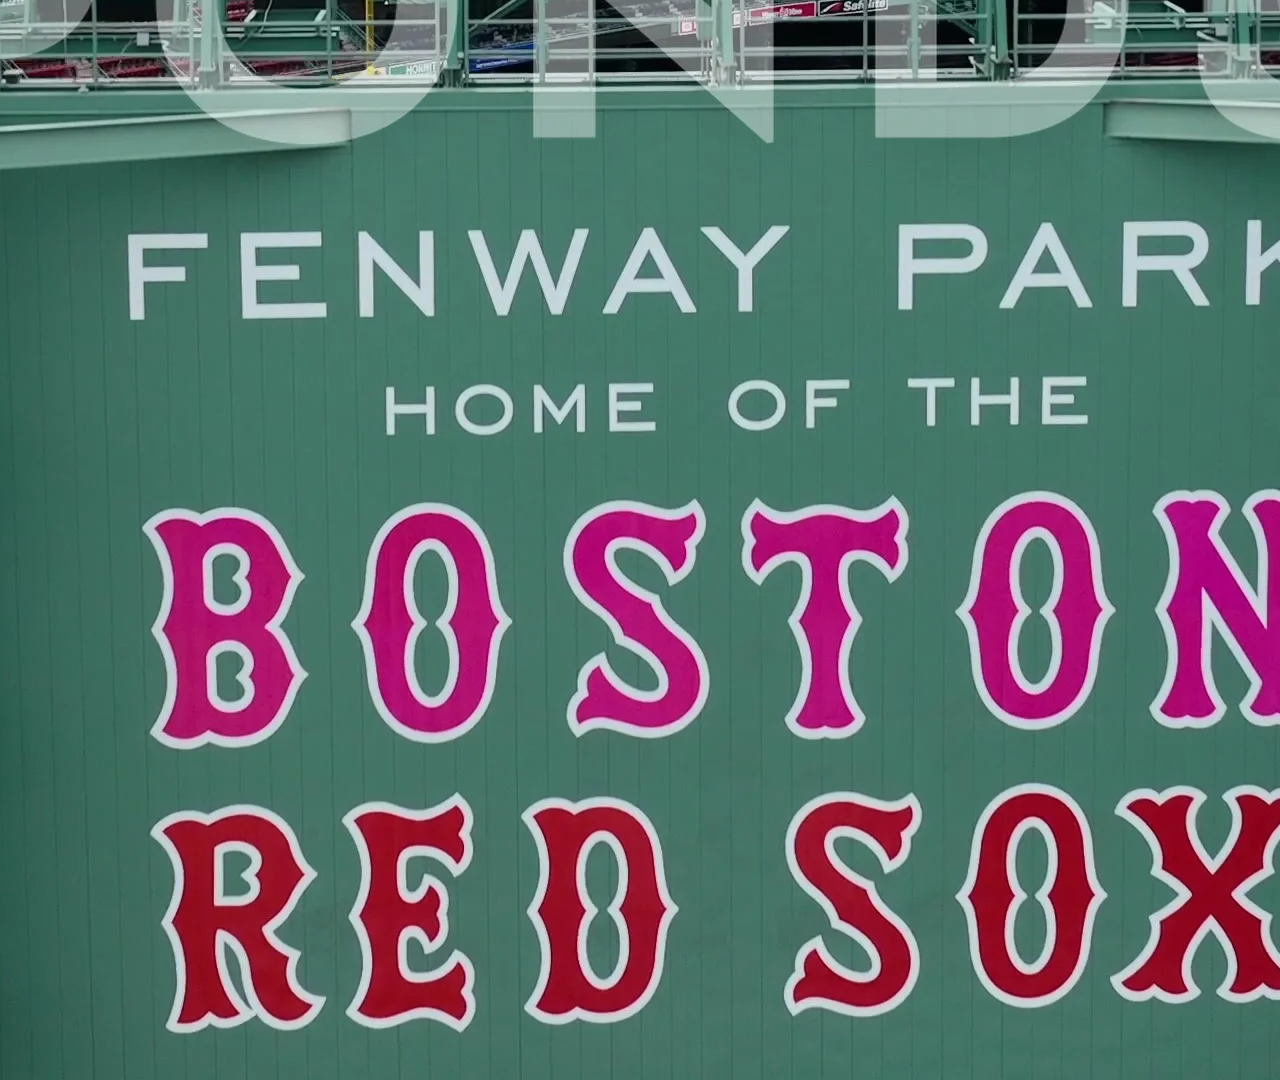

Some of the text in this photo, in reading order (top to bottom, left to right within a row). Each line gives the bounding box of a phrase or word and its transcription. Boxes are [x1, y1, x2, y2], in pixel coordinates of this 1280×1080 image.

[843, 0, 887, 13] Saflite
[127, 227, 791, 320] FENWAY
[386, 377, 1089, 436] HOME OF THE
[151, 793, 680, 1035] RED
